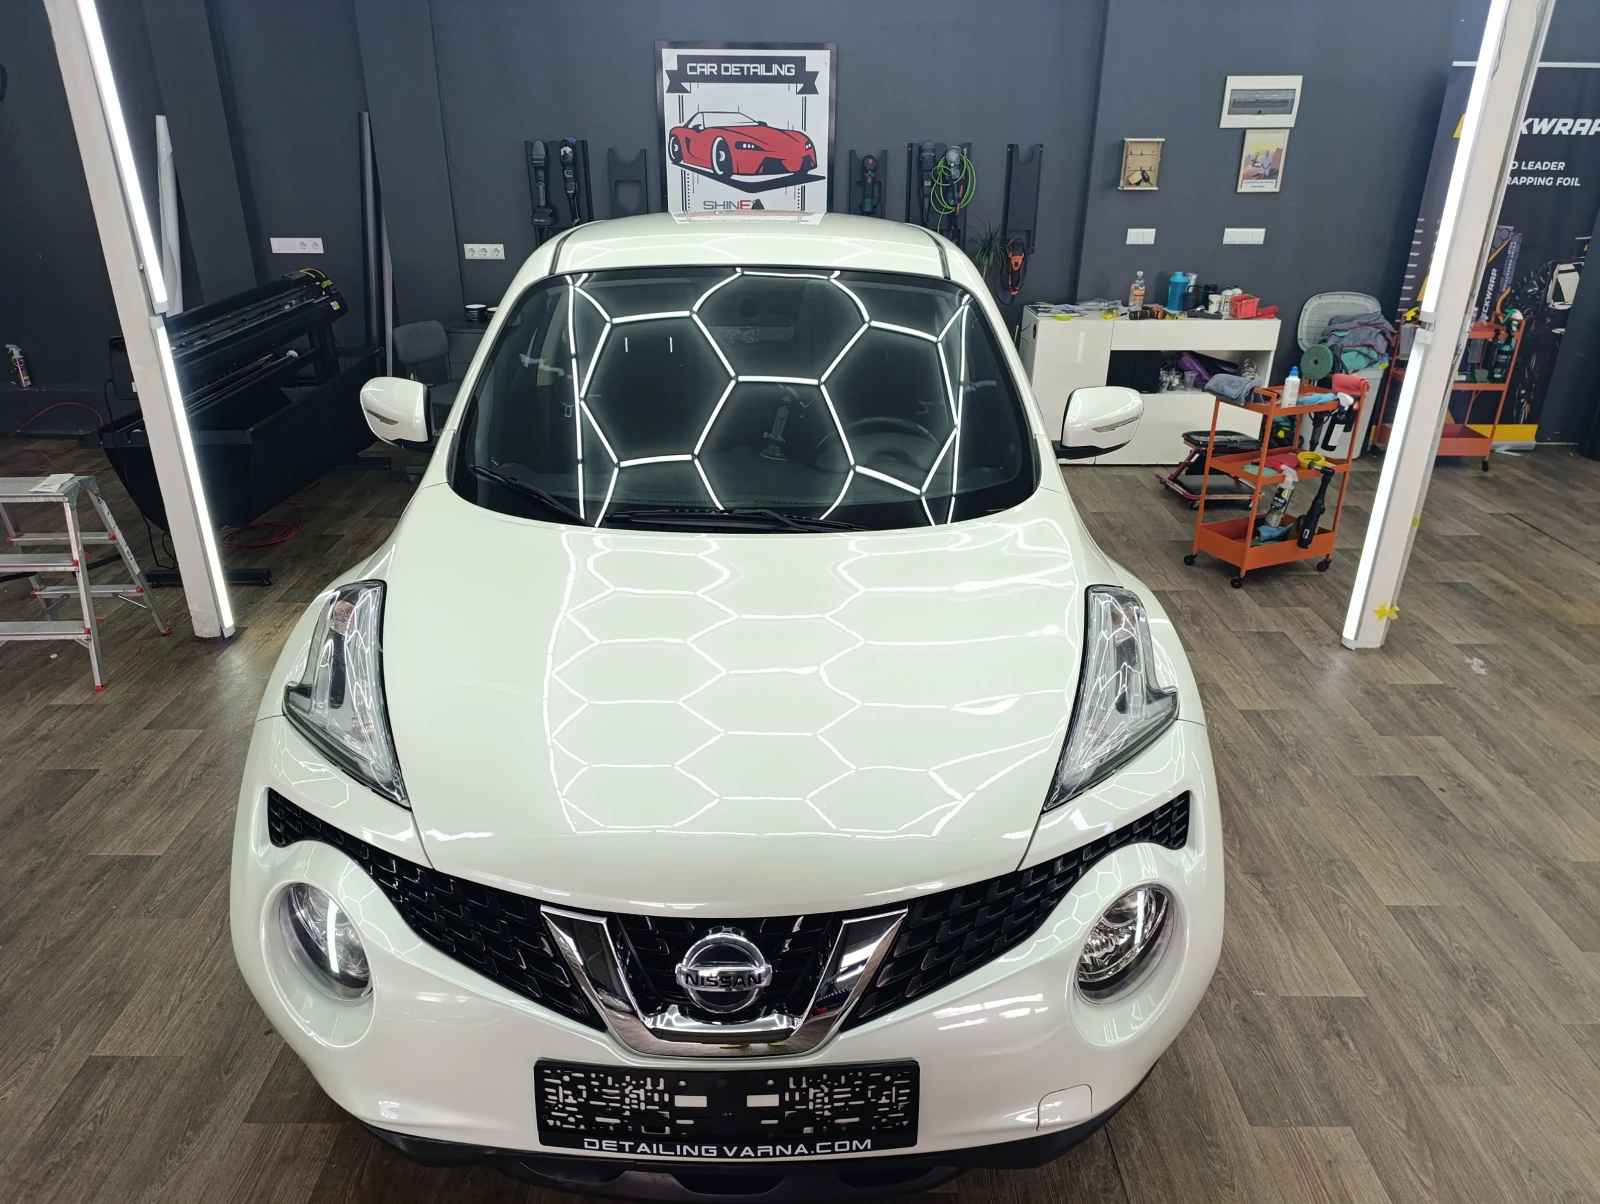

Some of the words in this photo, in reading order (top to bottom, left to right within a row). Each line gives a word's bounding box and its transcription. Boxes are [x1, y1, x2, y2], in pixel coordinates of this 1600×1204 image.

[686, 63, 718, 76] CAR
[721, 63, 796, 77] DETAILING
[1519, 117, 1600, 136] KWRAP
[1520, 161, 1566, 171] LEADER
[1505, 176, 1554, 186] RAPPING
[1555, 177, 1581, 187] FOIL
[685, 973, 763, 988] NISSAN
